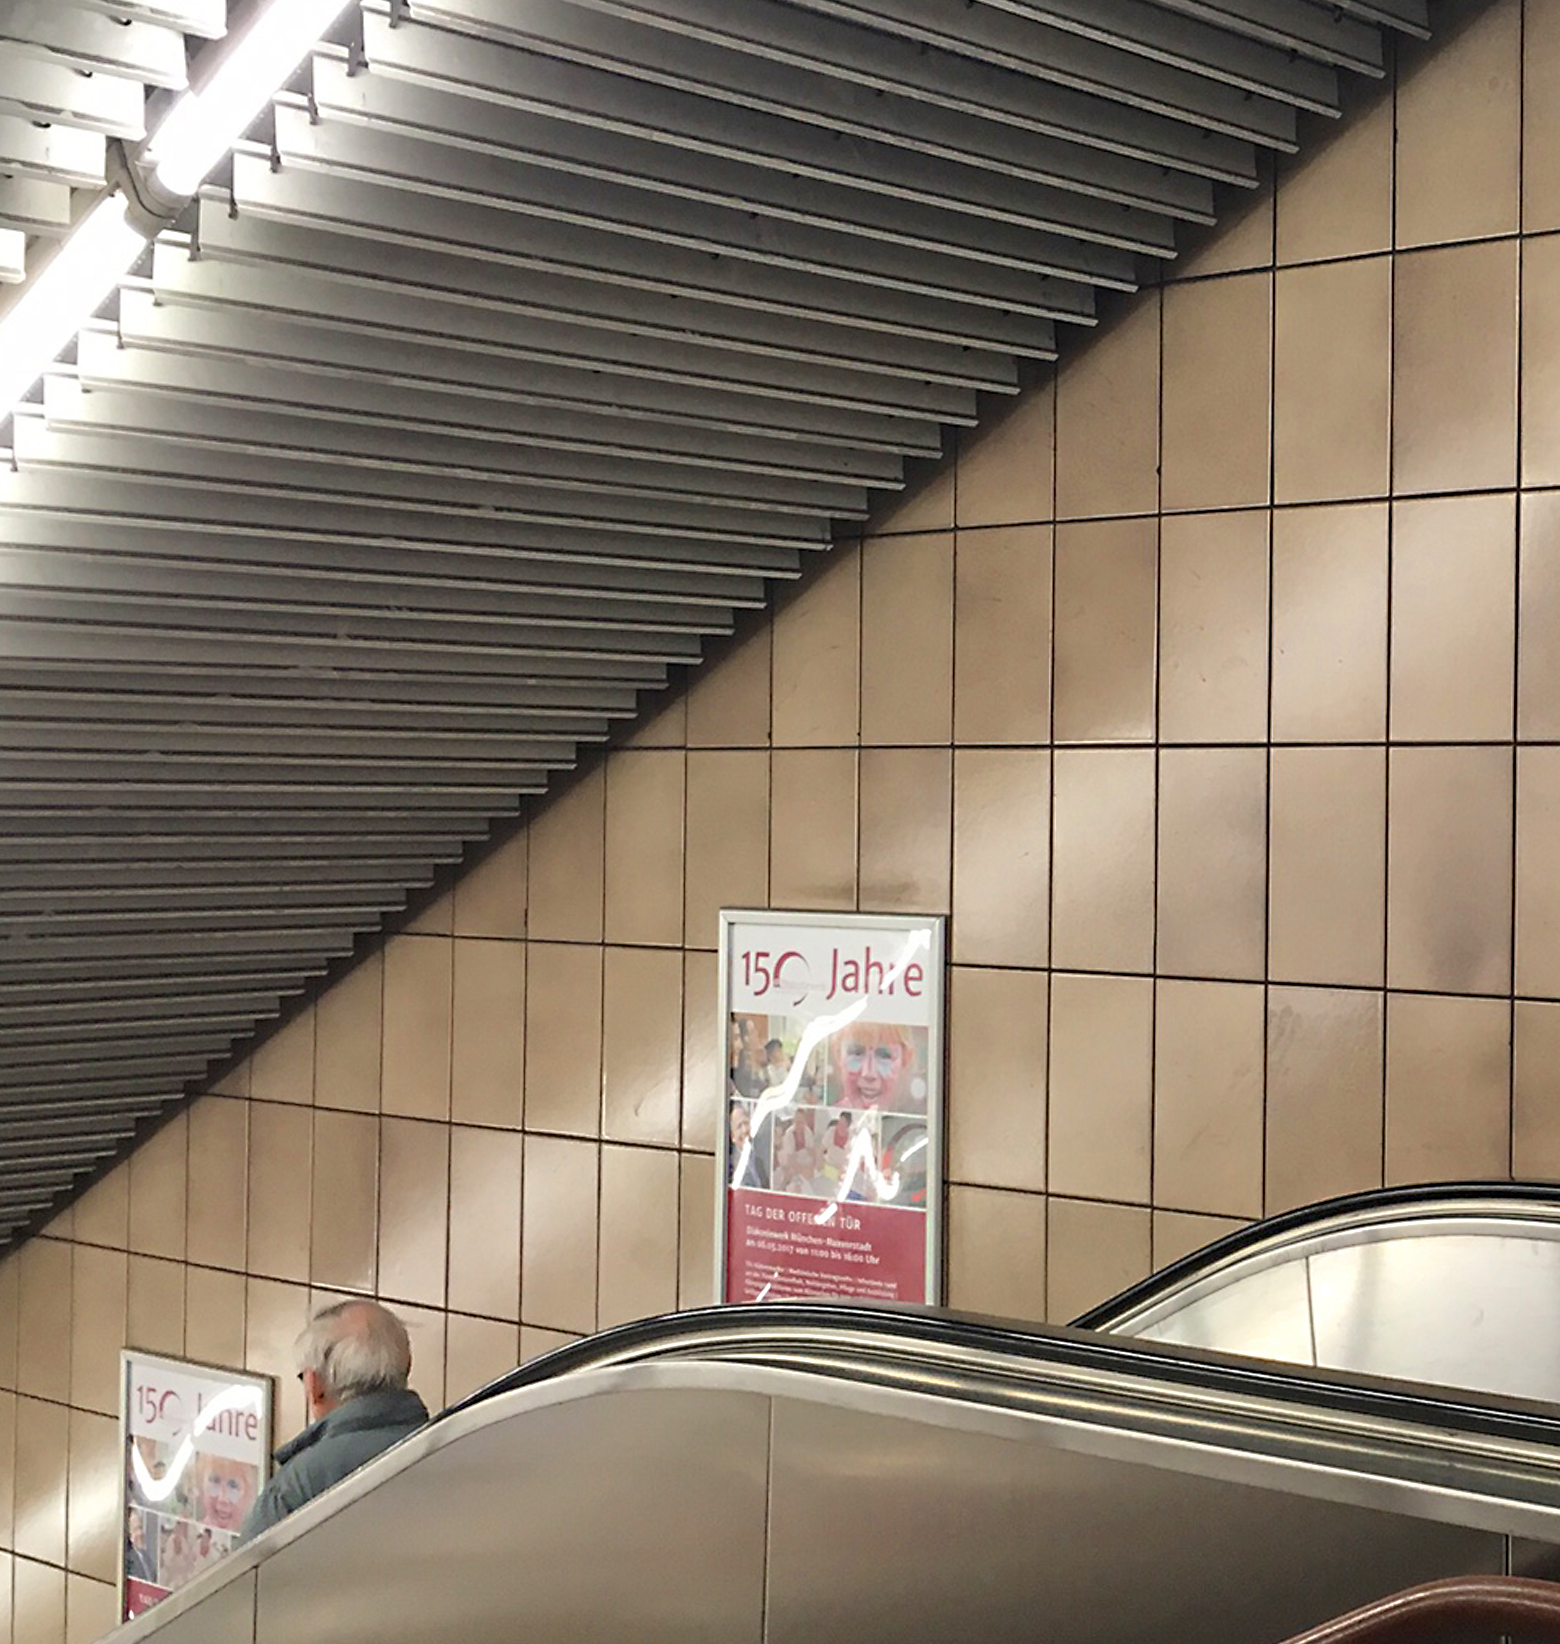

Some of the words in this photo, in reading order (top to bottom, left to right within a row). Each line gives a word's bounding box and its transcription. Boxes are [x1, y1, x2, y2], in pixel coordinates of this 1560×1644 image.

[741, 950, 812, 1007] 150
[826, 946, 924, 1001] Jahre
[744, 1203, 763, 1217] TAG
[766, 1207, 785, 1221] DER
[788, 1211, 836, 1228] OFFEEN
[839, 1215, 861, 1230] TÜR
